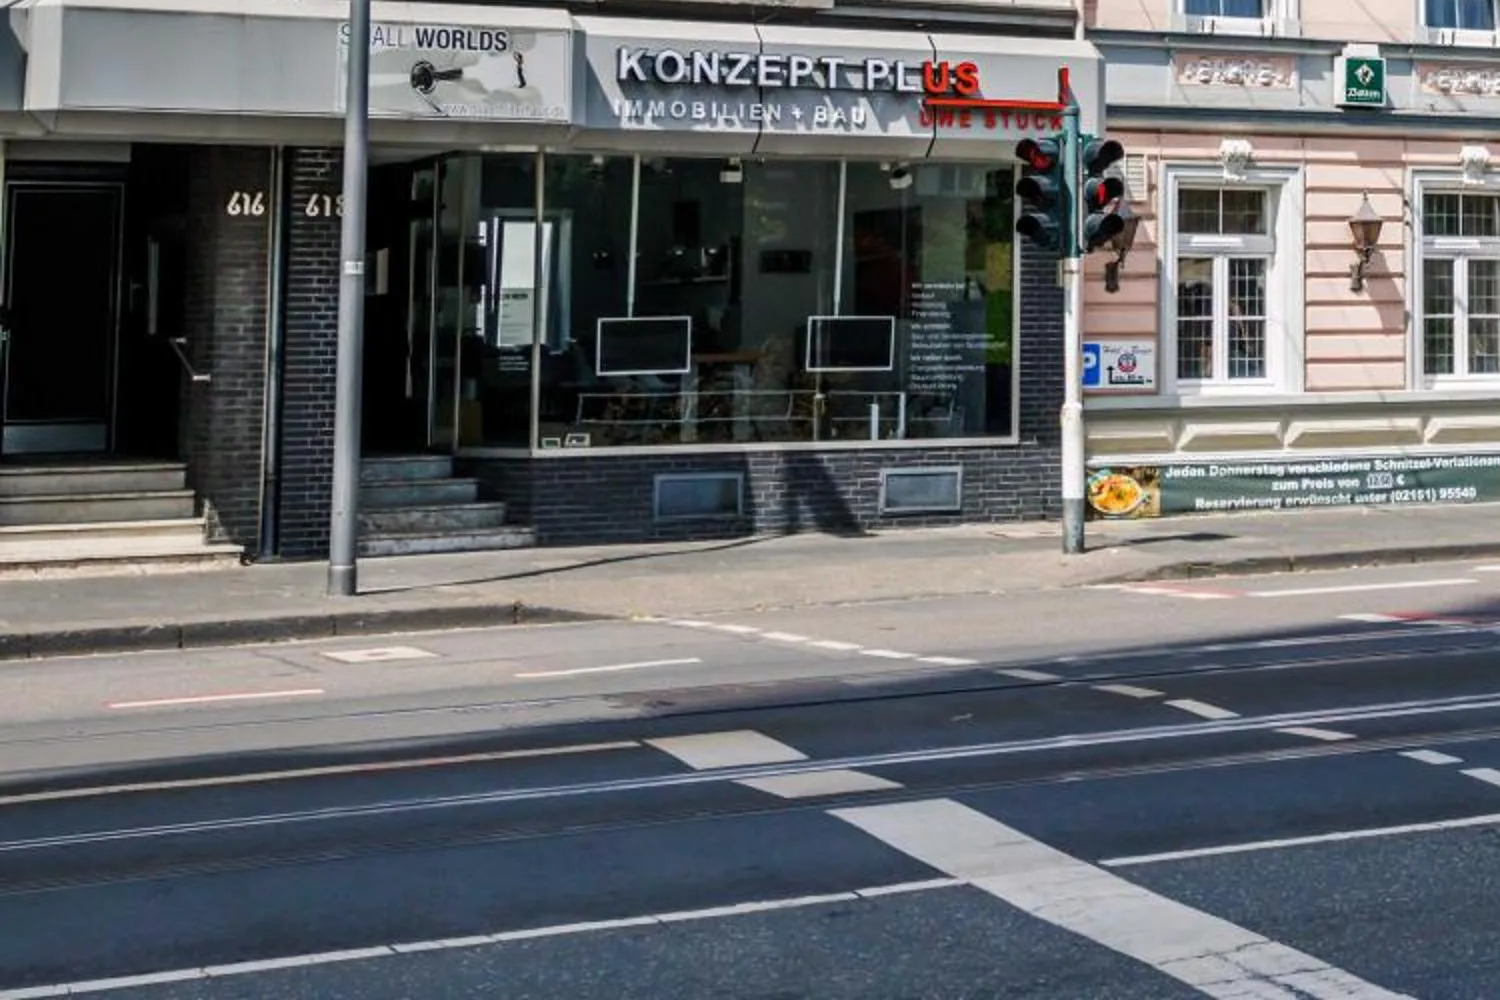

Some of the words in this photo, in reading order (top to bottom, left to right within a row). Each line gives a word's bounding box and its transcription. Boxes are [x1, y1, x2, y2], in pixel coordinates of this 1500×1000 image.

[341, 24, 408, 47] SALL
[415, 27, 508, 51] WORLDS
[618, 47, 845, 89] KONZEPT
[866, 59, 980, 95] PLUS
[615, 100, 781, 121] IMMOBILIEN
[792, 107, 804, 120] +
[814, 104, 866, 124] BAU
[227, 191, 265, 216] 616
[1165, 465, 1206, 478] Jeden
[1209, 463, 1285, 477] Donnerstag
[1288, 461, 1371, 474] verschiedene
[1271, 480, 1299, 491] zum
[1302, 477, 1335, 490] Preis
[1337, 477, 1361, 489] von
[1195, 496, 1281, 509] Reservierung
[1286, 493, 1350, 506] erwünscht
[1355, 492, 1387, 504] unter
